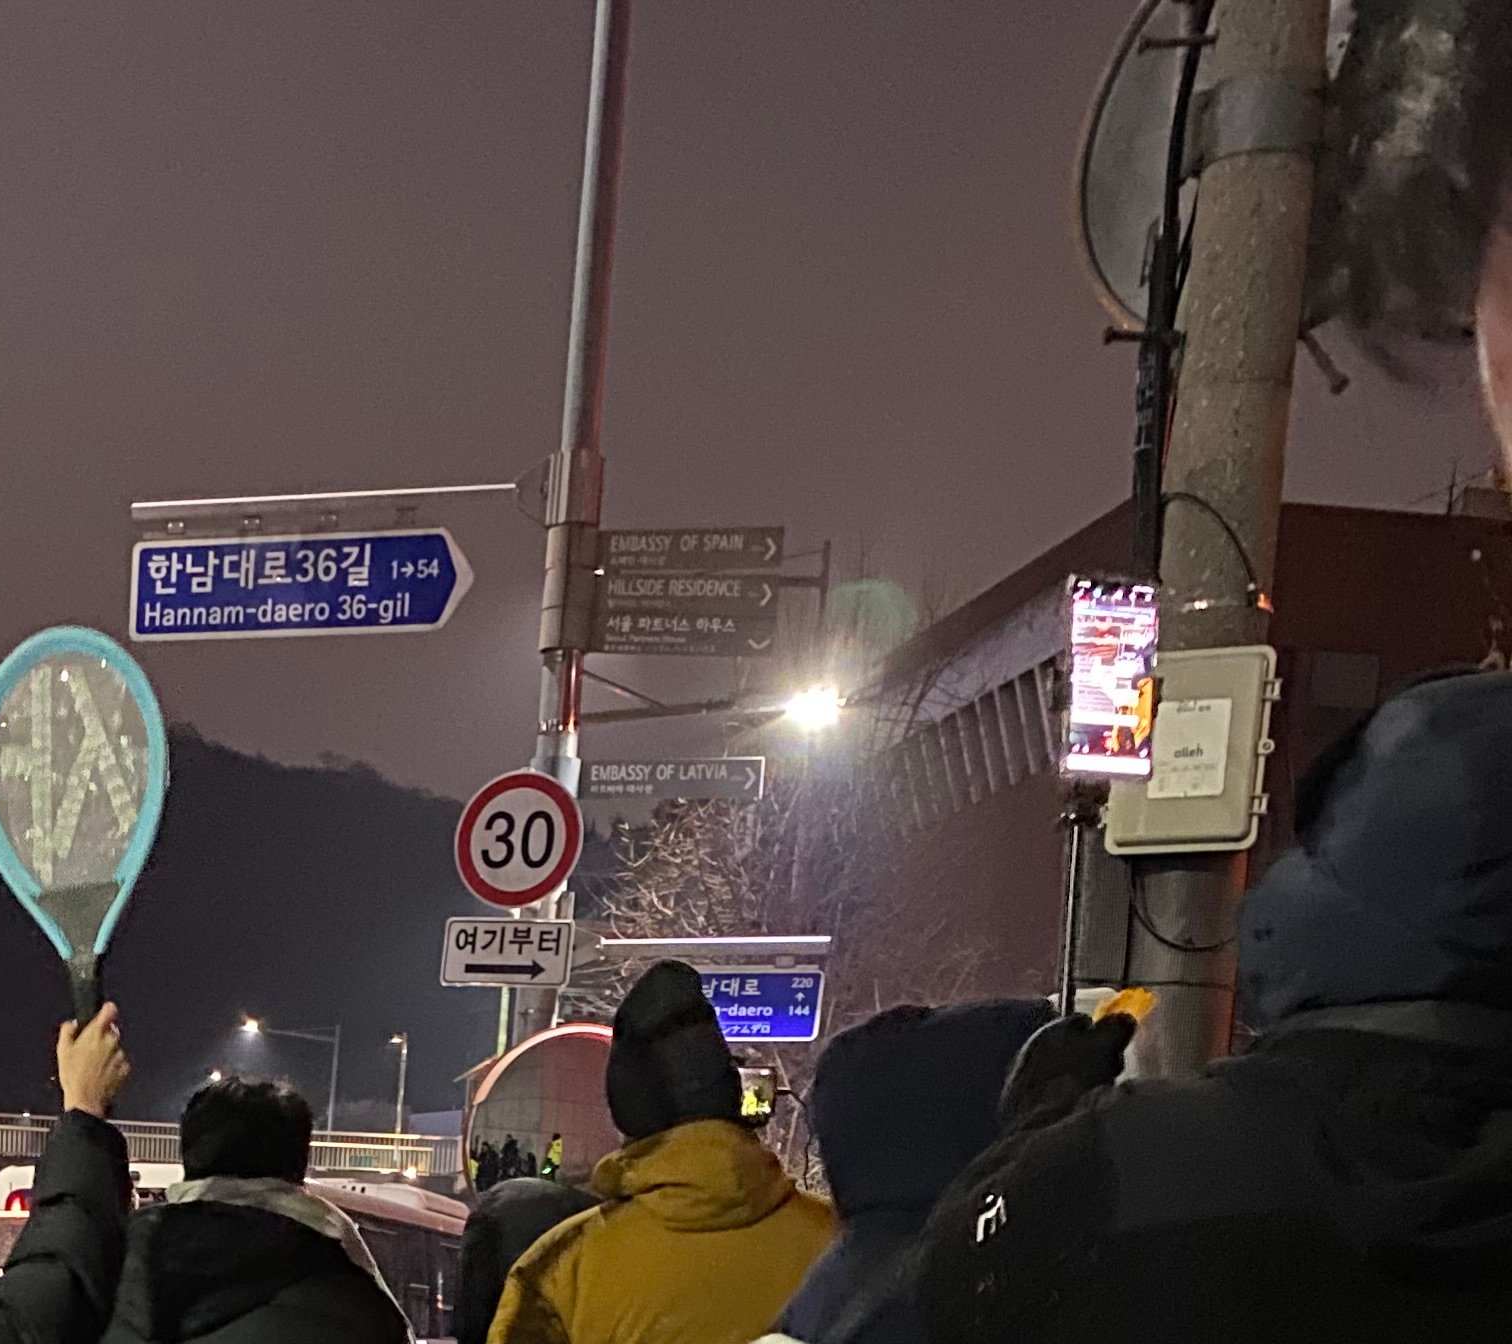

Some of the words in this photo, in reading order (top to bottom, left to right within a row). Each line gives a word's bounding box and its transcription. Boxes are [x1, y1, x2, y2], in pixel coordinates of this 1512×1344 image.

[610, 535, 673, 552] EMBASSY
[680, 535, 699, 551] OF
[703, 534, 745, 550] SPAIN
[146, 543, 372, 594] 한남대로36길
[608, 579, 665, 596] HILLSIDE
[668, 579, 741, 597] RESIDENCE
[143, 598, 330, 627] Hannam-daero
[337, 592, 410, 624] 36-gil
[606, 616, 633, 632] 서울
[638, 616, 690, 632] 파트너스
[696, 617, 736, 633] 하우스
[590, 765, 652, 781] EMBASSY
[656, 764, 676, 780] OF
[679, 763, 728, 780] LATVIA
[481, 810, 555, 869] 30
[455, 926, 562, 956] 여기부터
[791, 977, 814, 989] 220
[789, 1005, 810, 1016] 144
